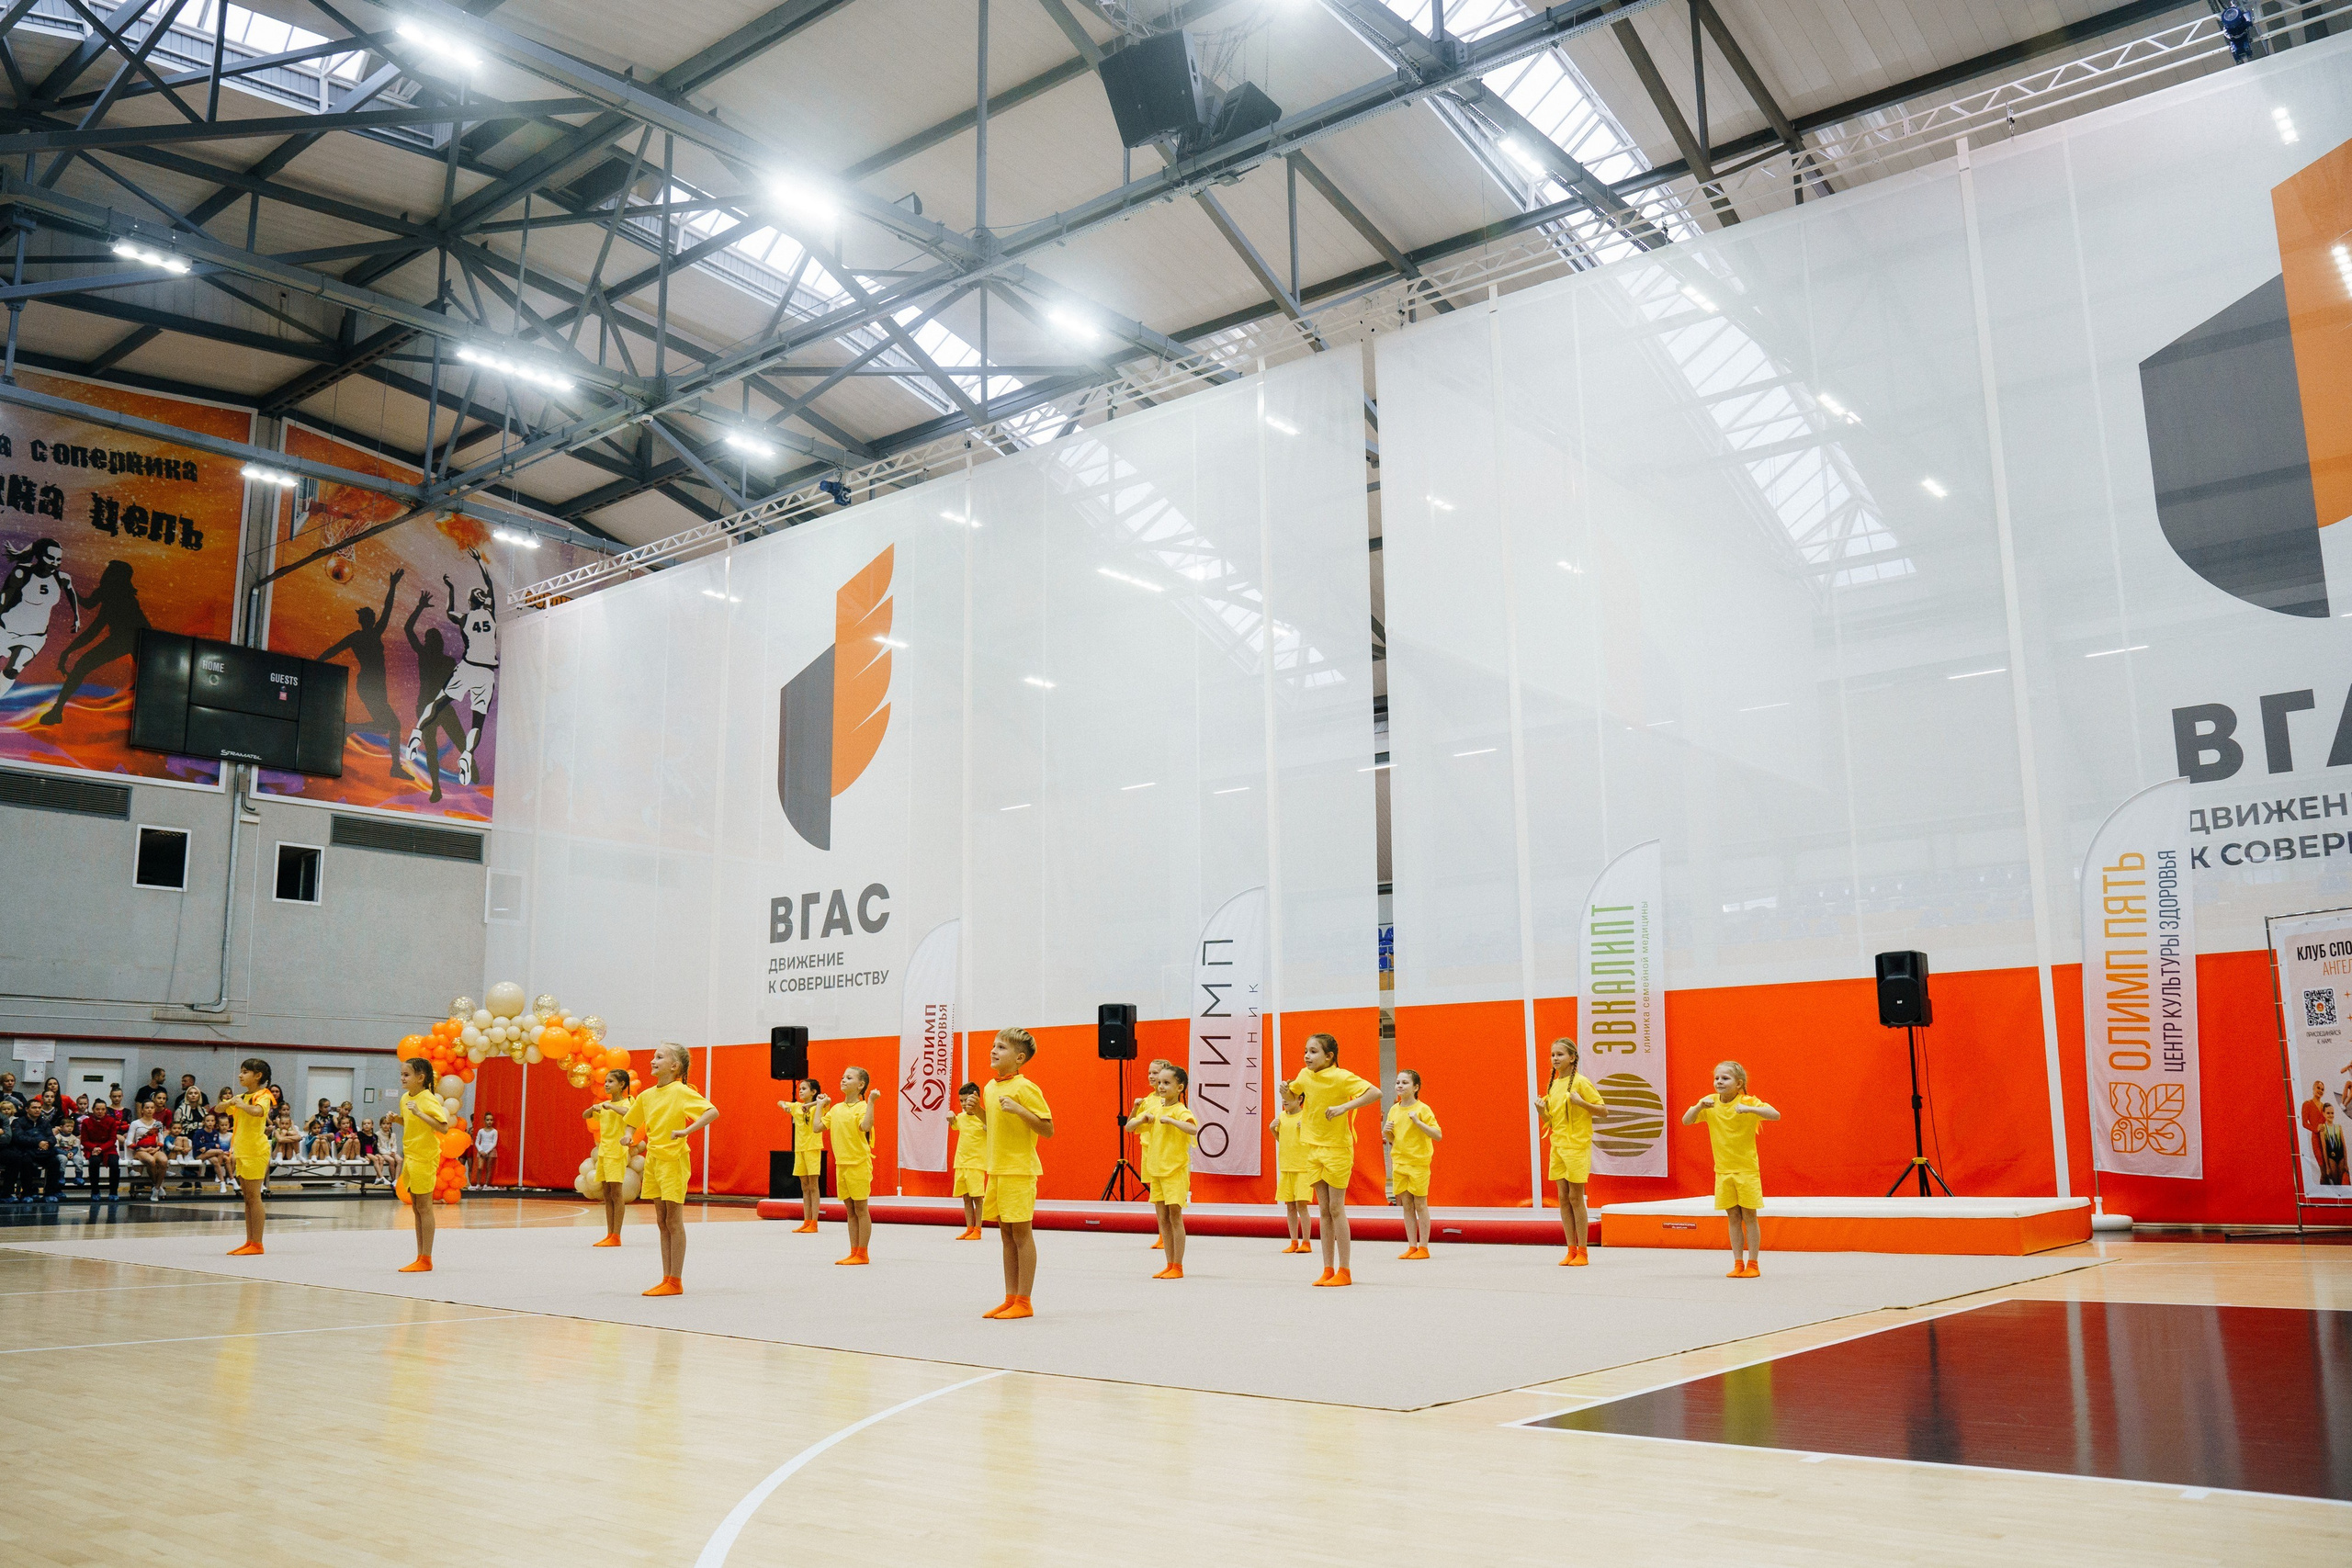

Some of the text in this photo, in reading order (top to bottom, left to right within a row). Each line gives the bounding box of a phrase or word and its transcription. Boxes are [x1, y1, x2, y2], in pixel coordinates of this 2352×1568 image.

[30, 439, 198, 482] соперника
[0, 473, 204, 551] на цель
[40, 584, 49, 595] 5
[471, 620, 492, 633] 45
[202, 660, 225, 673] HOME
[270, 672, 299, 686] GUESTS
[220, 749, 262, 761] STRAMATEL
[2190, 792, 2352, 835] ДВИЖЕН
[2191, 831, 2352, 870] К СОВЕР
[770, 883, 890, 944] ВГАС
[1641, 900, 1649, 953] медицины
[768, 952, 844, 975] ДВИЖЕНИЕ
[2102, 852, 2152, 1071] ОЛИМП ПЯТЬ
[2157, 850, 2186, 1072] ЦЕНТР КУЛЬТУРЫ ЗДОРОВЬЯ
[2297, 944, 2326, 961] КЛУБ
[768, 970, 889, 994] К СОВЕРШЕНСТВУ
[1590, 904, 1637, 1055] ЭВКАЛИПТ
[1641, 956, 1650, 1008] семейной
[922, 1004, 937, 1076] ОЛИМП
[936, 1004, 947, 1076] ЗДОРОВЬЯ
[1197, 939, 1234, 1158] ОЛИМП
[1245, 983, 1259, 1115] КЛИНИК
